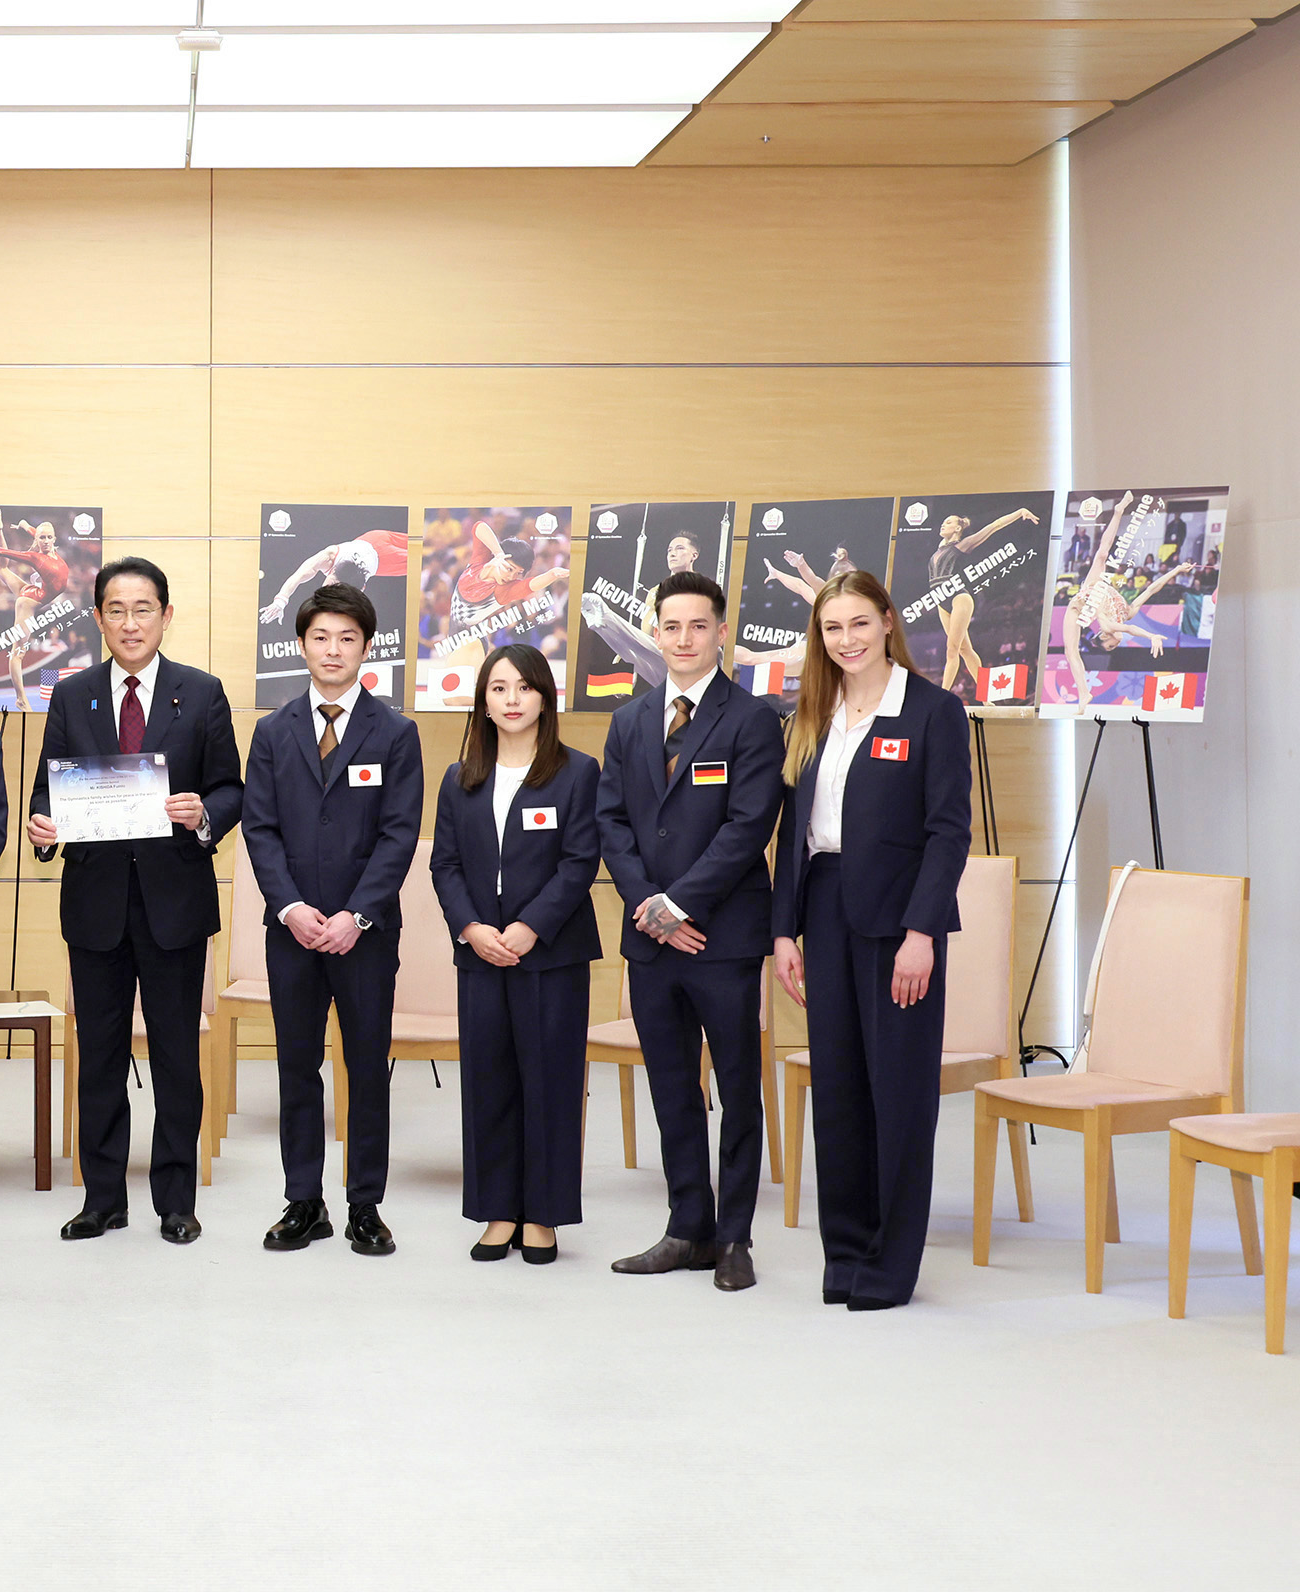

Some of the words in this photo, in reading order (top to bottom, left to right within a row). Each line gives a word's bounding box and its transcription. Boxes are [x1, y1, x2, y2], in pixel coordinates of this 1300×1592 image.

[1105, 494, 1154, 569] Katharine
[902, 573, 965, 624] SPENCE
[963, 542, 1017, 583] Emma
[972, 548, 1038, 594] エマ・スペンス
[24, 599, 75, 634] Nastia
[591, 576, 652, 620] NGUYEN
[433, 606, 523, 657] MURAKAMI
[522, 590, 555, 616] Mai
[515, 620, 535, 635] 村上
[742, 623, 806, 648] CHARPY
[261, 639, 301, 660] UCHI
